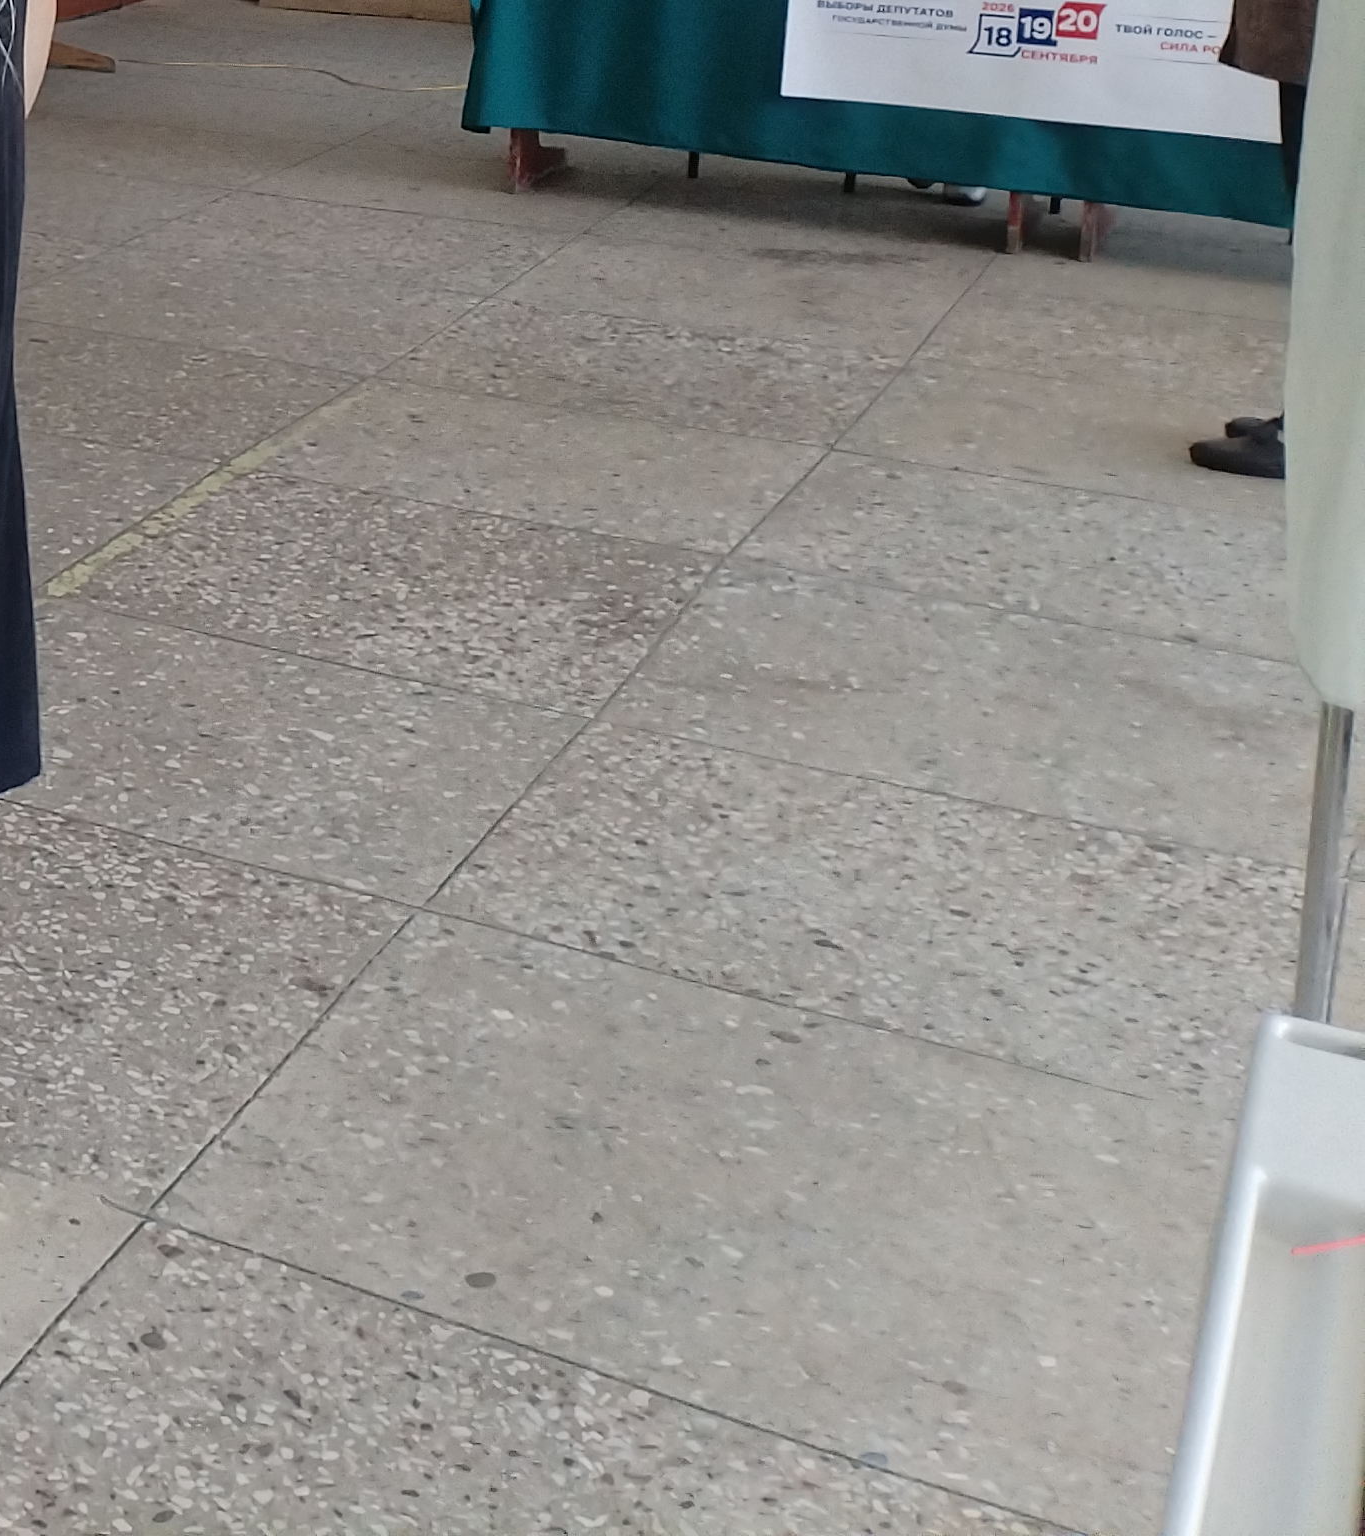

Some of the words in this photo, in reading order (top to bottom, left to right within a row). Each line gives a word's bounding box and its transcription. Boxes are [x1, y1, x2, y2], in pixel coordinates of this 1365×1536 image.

[816, 0, 874, 12] ВЫБОРЫ
[876, 4, 954, 19] ДЕПУТАТОВ
[981, 1, 1015, 13] 2026
[984, 26, 1013, 48] 18
[1020, 15, 1052, 40] 19
[1058, 9, 1099, 33] 20
[1115, 23, 1153, 35] ТВОЙ
[1156, 27, 1204, 40] ГОЛОС
[1160, 42, 1198, 52] СИЛА
[1021, 49, 1099, 66] СЕНТЯБРЯ
